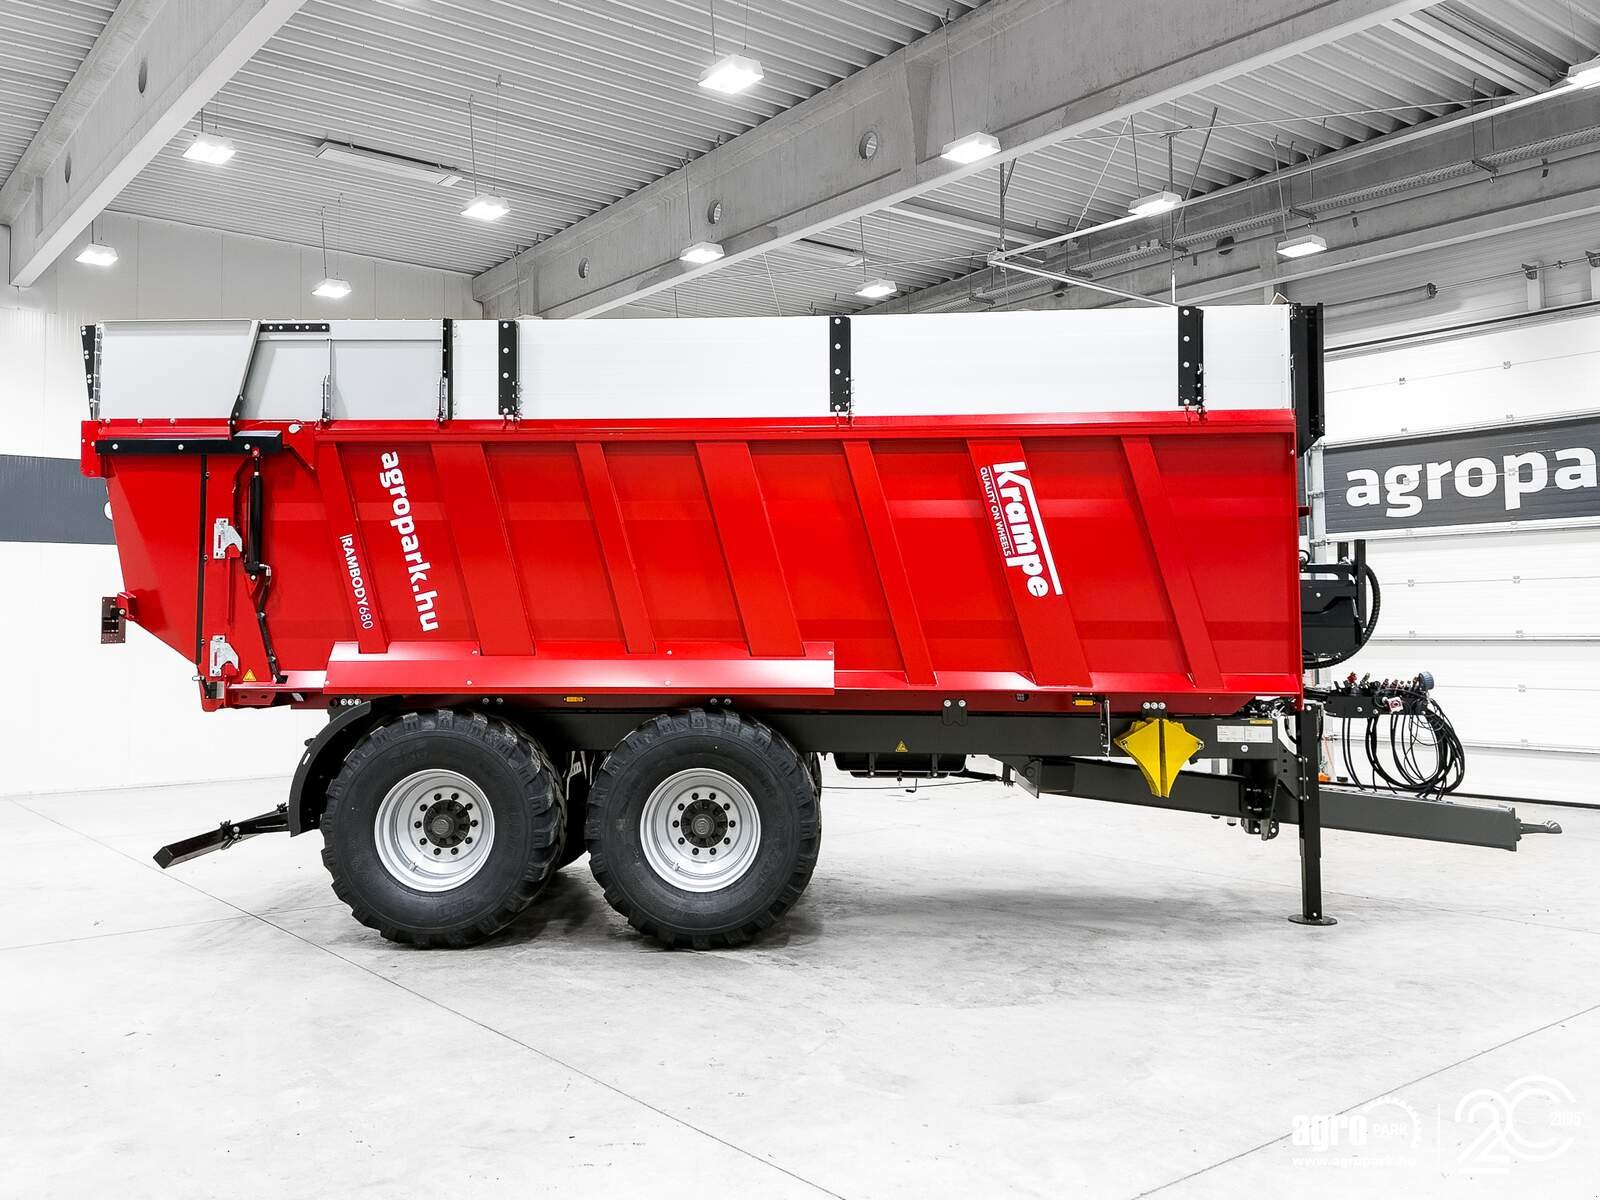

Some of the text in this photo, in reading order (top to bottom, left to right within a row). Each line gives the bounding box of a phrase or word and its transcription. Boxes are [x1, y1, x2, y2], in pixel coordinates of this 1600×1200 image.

[980, 467, 1012, 557] QUALITY ON WHEELS
[993, 461, 1064, 598] Krampe
[1346, 447, 1598, 518] agropa
[379, 451, 439, 632] agropark.hu
